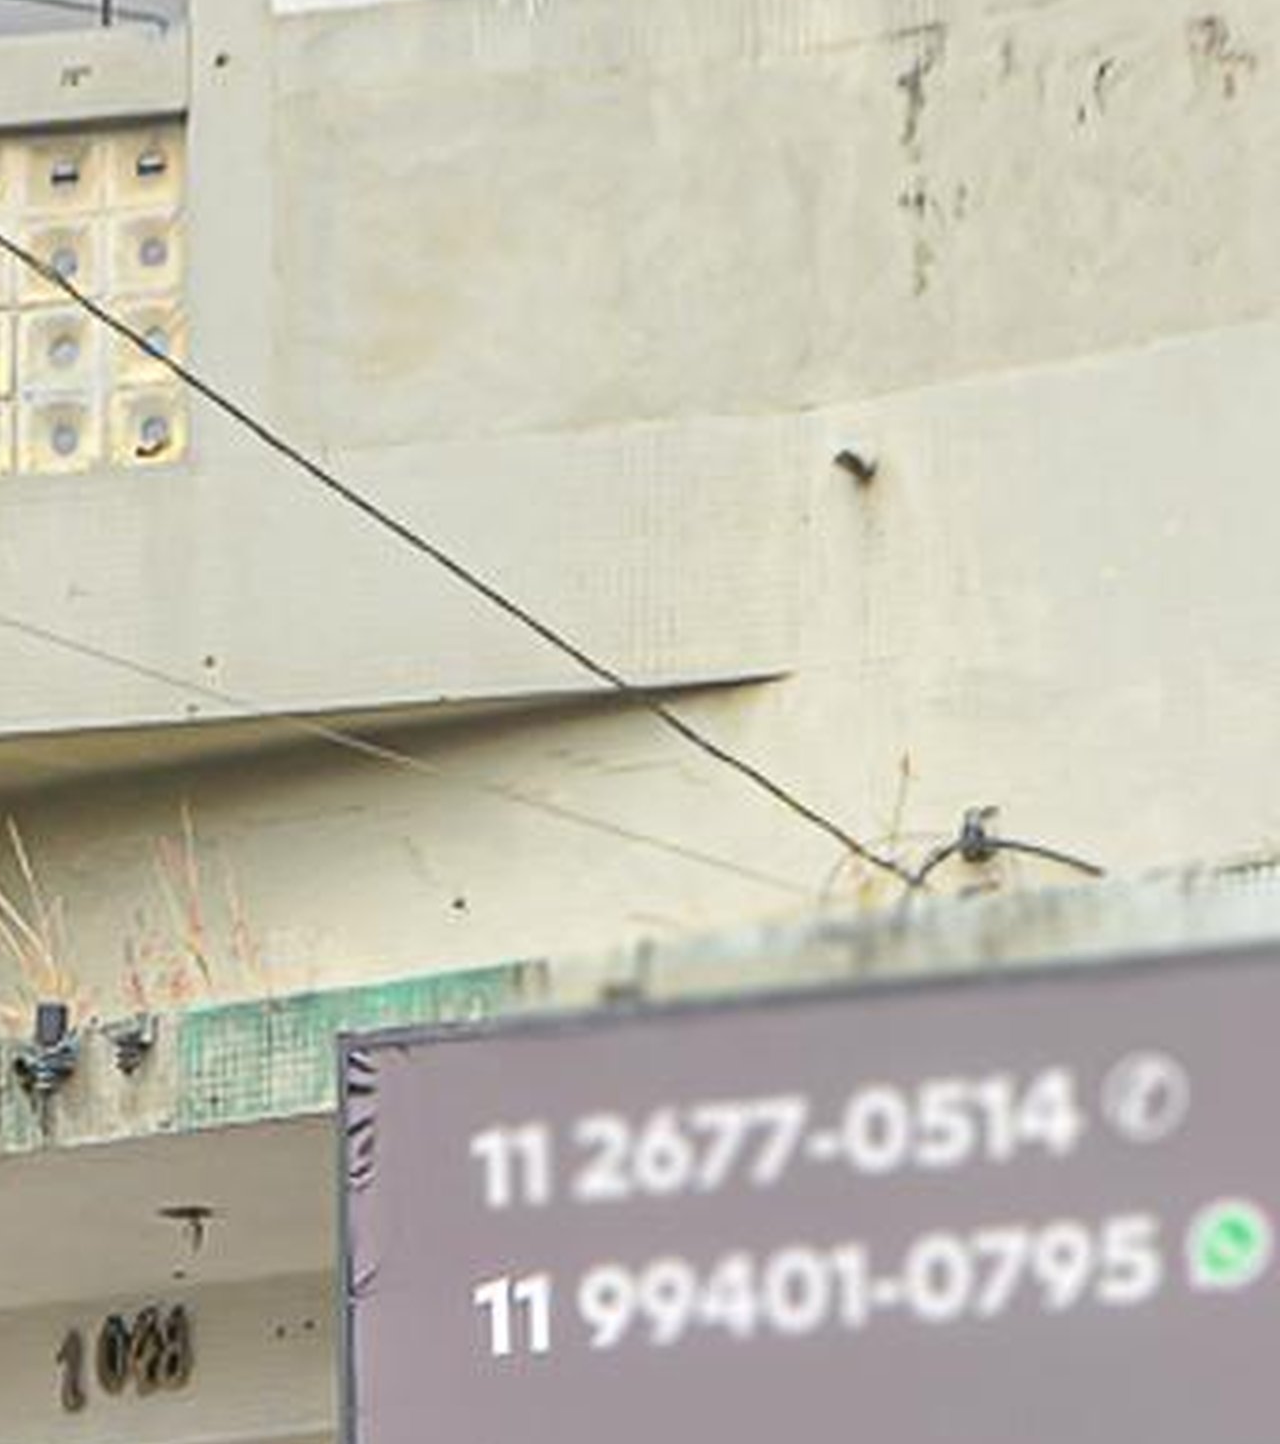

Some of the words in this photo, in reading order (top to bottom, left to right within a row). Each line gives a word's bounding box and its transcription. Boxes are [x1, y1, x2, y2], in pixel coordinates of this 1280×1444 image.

[471, 1122, 550, 1208] 11
[573, 1067, 1084, 1201] 2677-0514
[473, 1275, 552, 1356] 11
[577, 1212, 1162, 1349] 99401-0795
